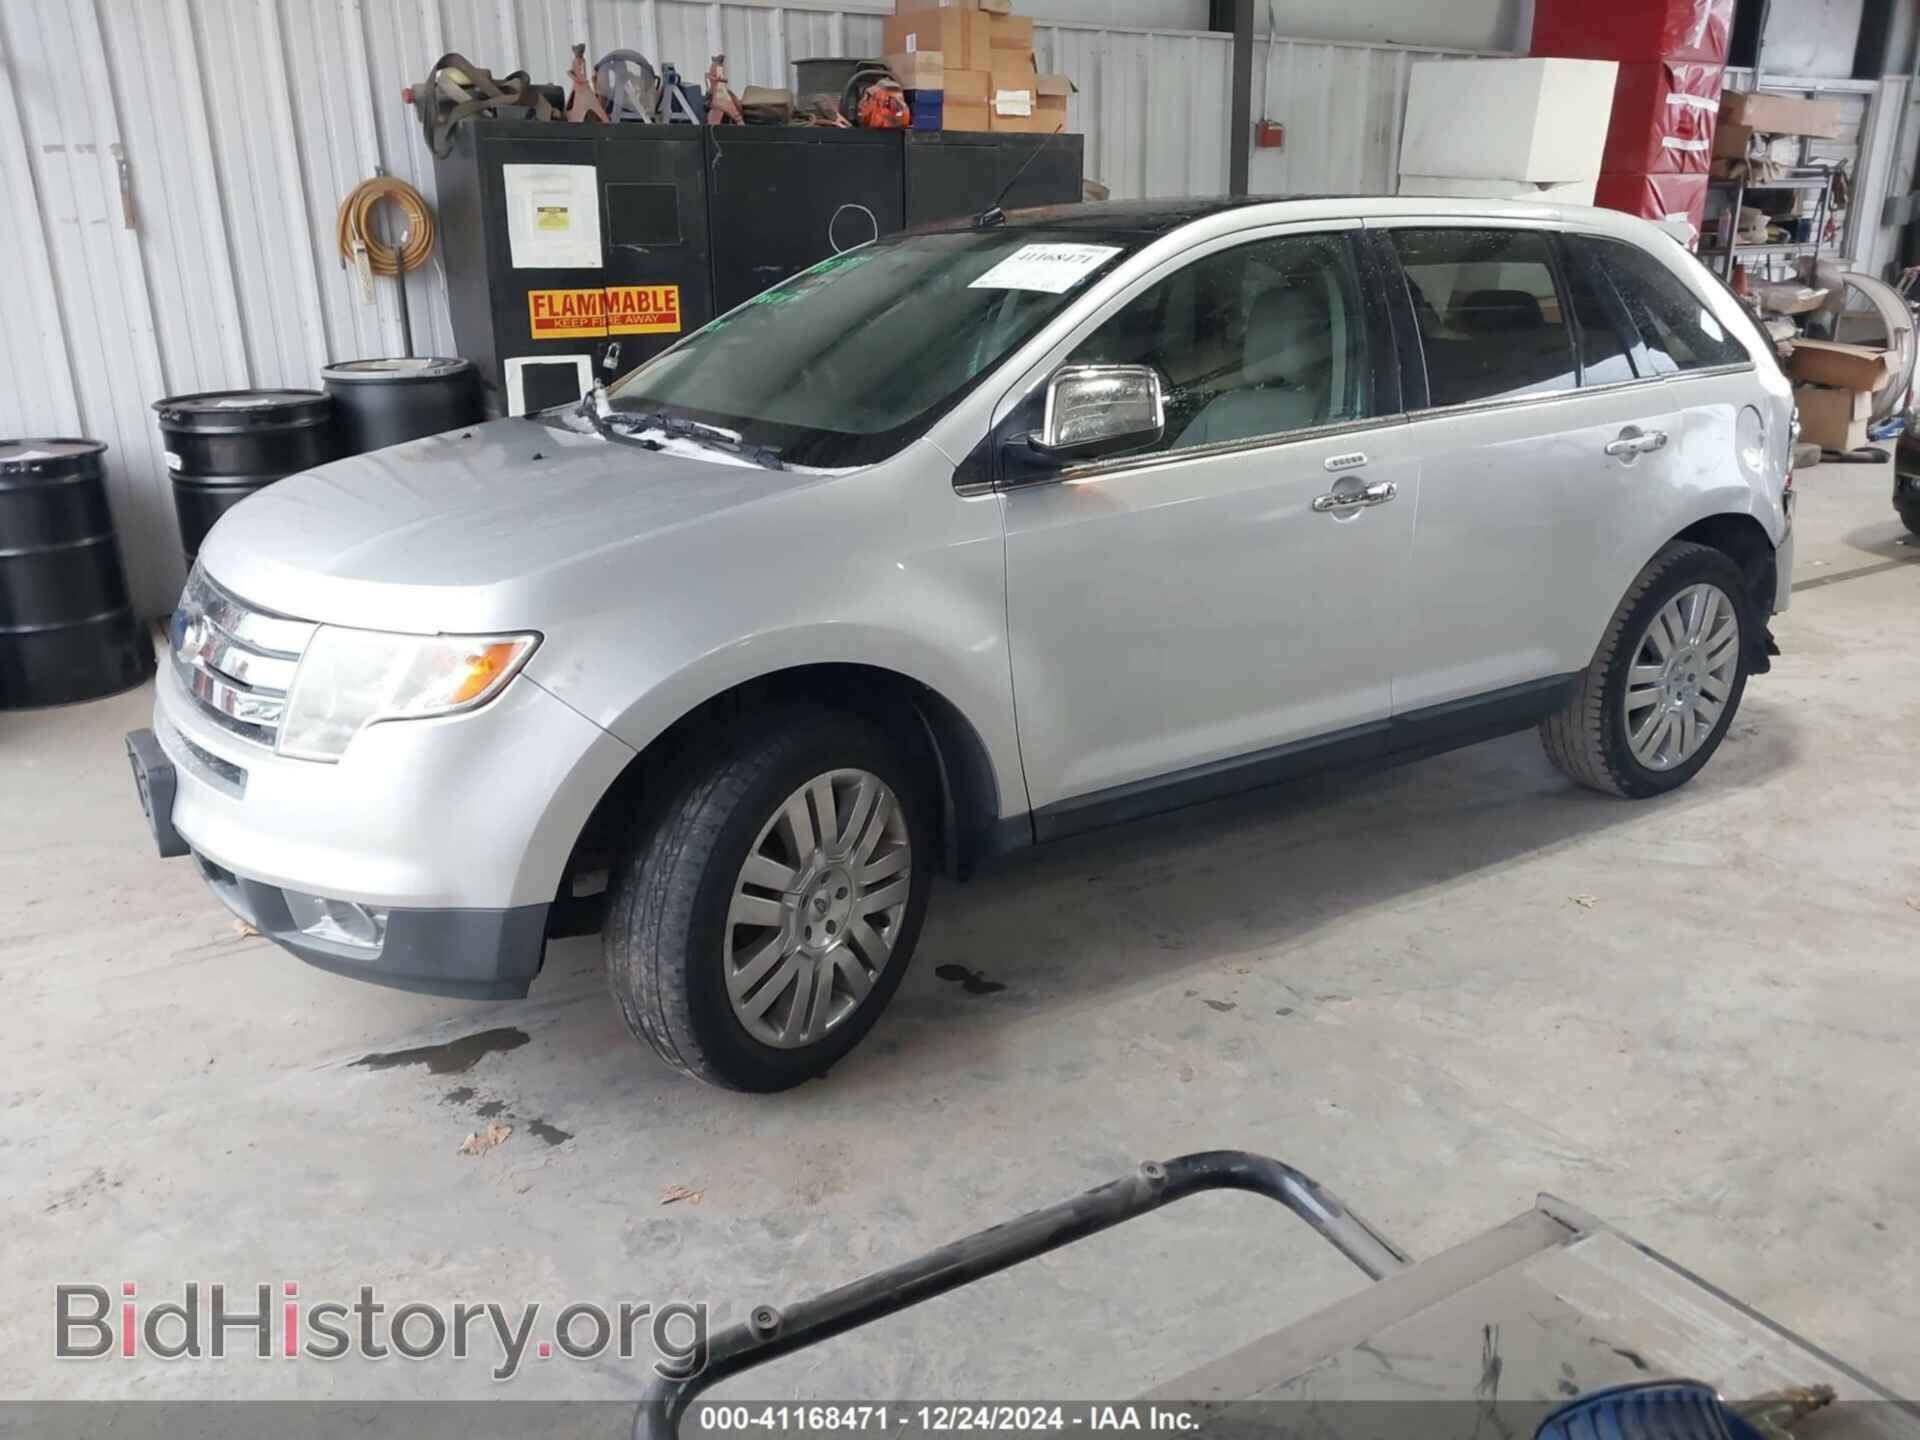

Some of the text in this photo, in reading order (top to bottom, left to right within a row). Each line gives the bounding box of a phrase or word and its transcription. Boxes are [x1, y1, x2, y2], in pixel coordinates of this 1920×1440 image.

[532, 289, 677, 318] FLAMMABLE
[553, 317, 588, 328] KEEP
[624, 314, 660, 325] AWAY
